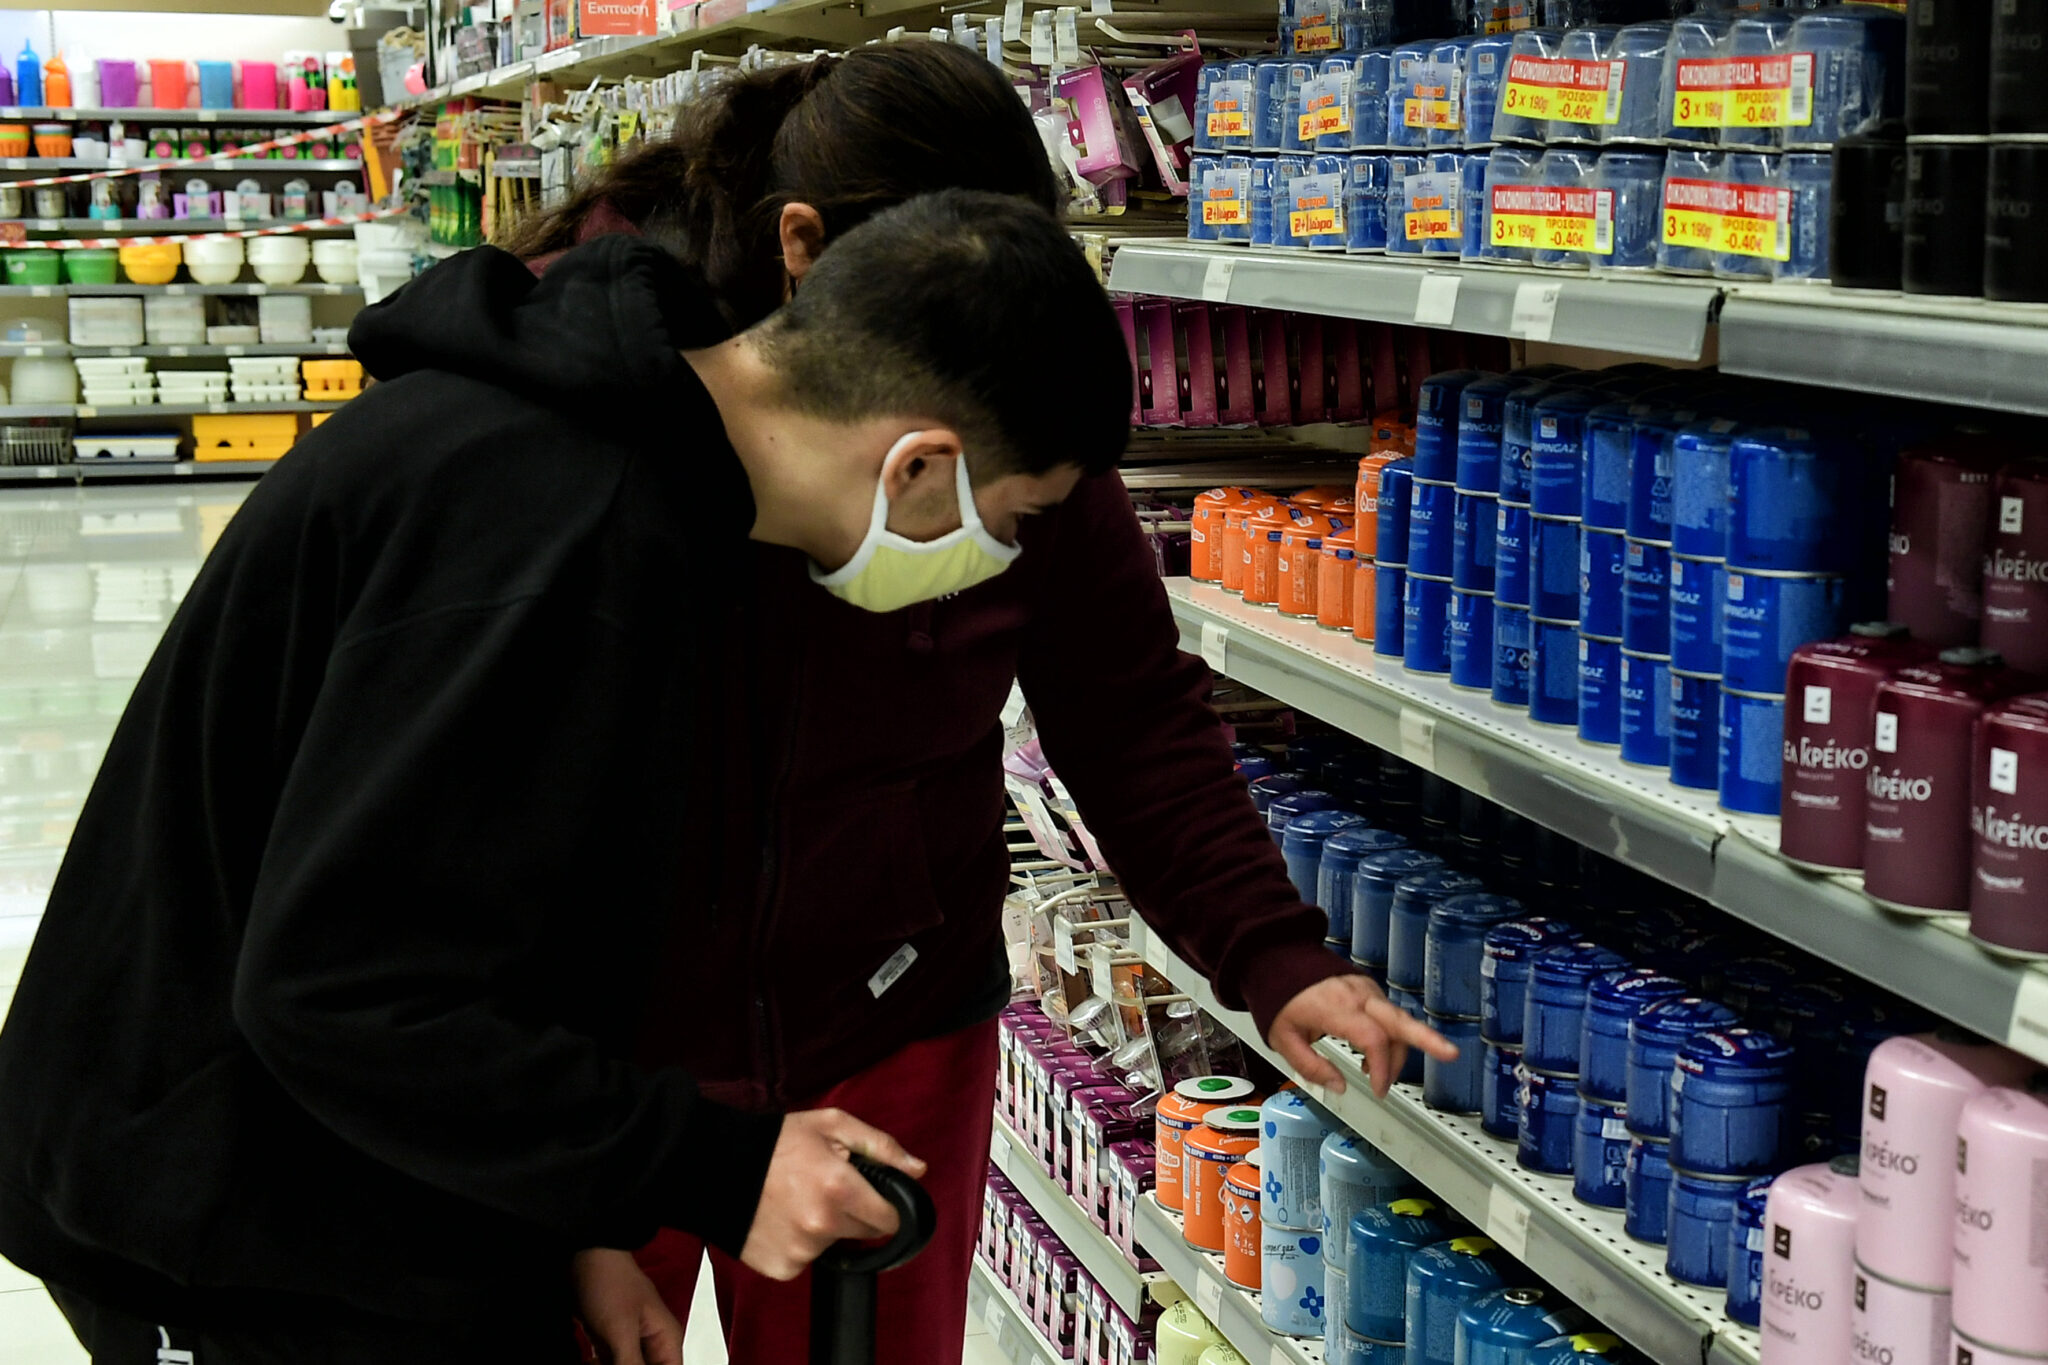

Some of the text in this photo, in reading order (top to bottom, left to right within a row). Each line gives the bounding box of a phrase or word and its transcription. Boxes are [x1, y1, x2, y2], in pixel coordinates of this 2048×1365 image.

[1507, 89, 1517, 108] 3
[1680, 98, 1690, 119] 3
[1496, 220, 1505, 239] 3
[1667, 216, 1676, 237] 3
